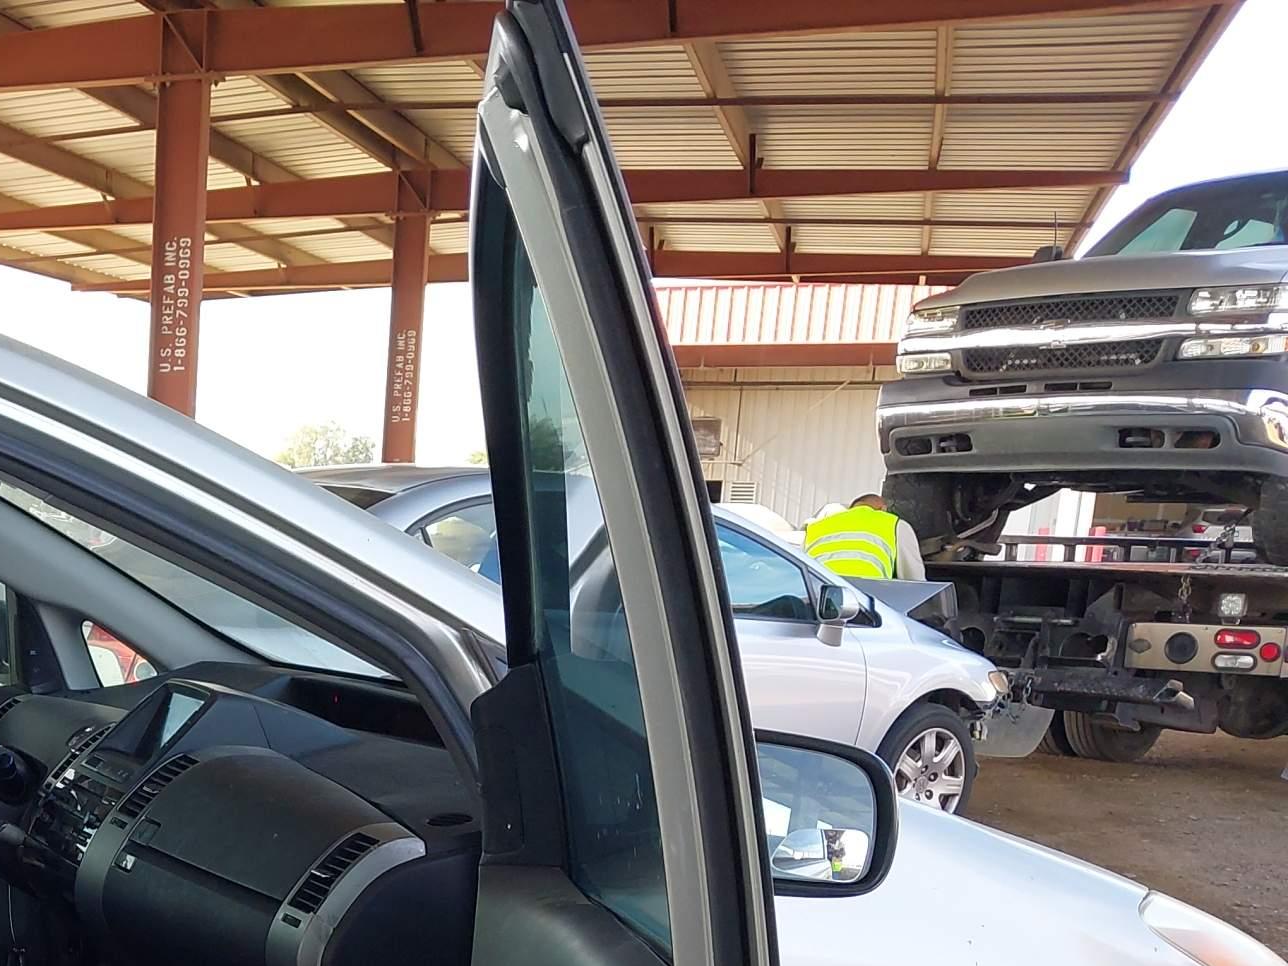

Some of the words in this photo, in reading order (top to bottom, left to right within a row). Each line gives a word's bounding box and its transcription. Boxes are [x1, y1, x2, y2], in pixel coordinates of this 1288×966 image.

[164, 236, 178, 267] INC.
[161, 273, 176, 335] PREFAB
[173, 237, 192, 372] 1-866-799-0969
[396, 329, 407, 350] INC.
[159, 343, 172, 373] U.S.
[393, 355, 405, 397] PREFAB
[391, 402, 402, 423] U.S.
